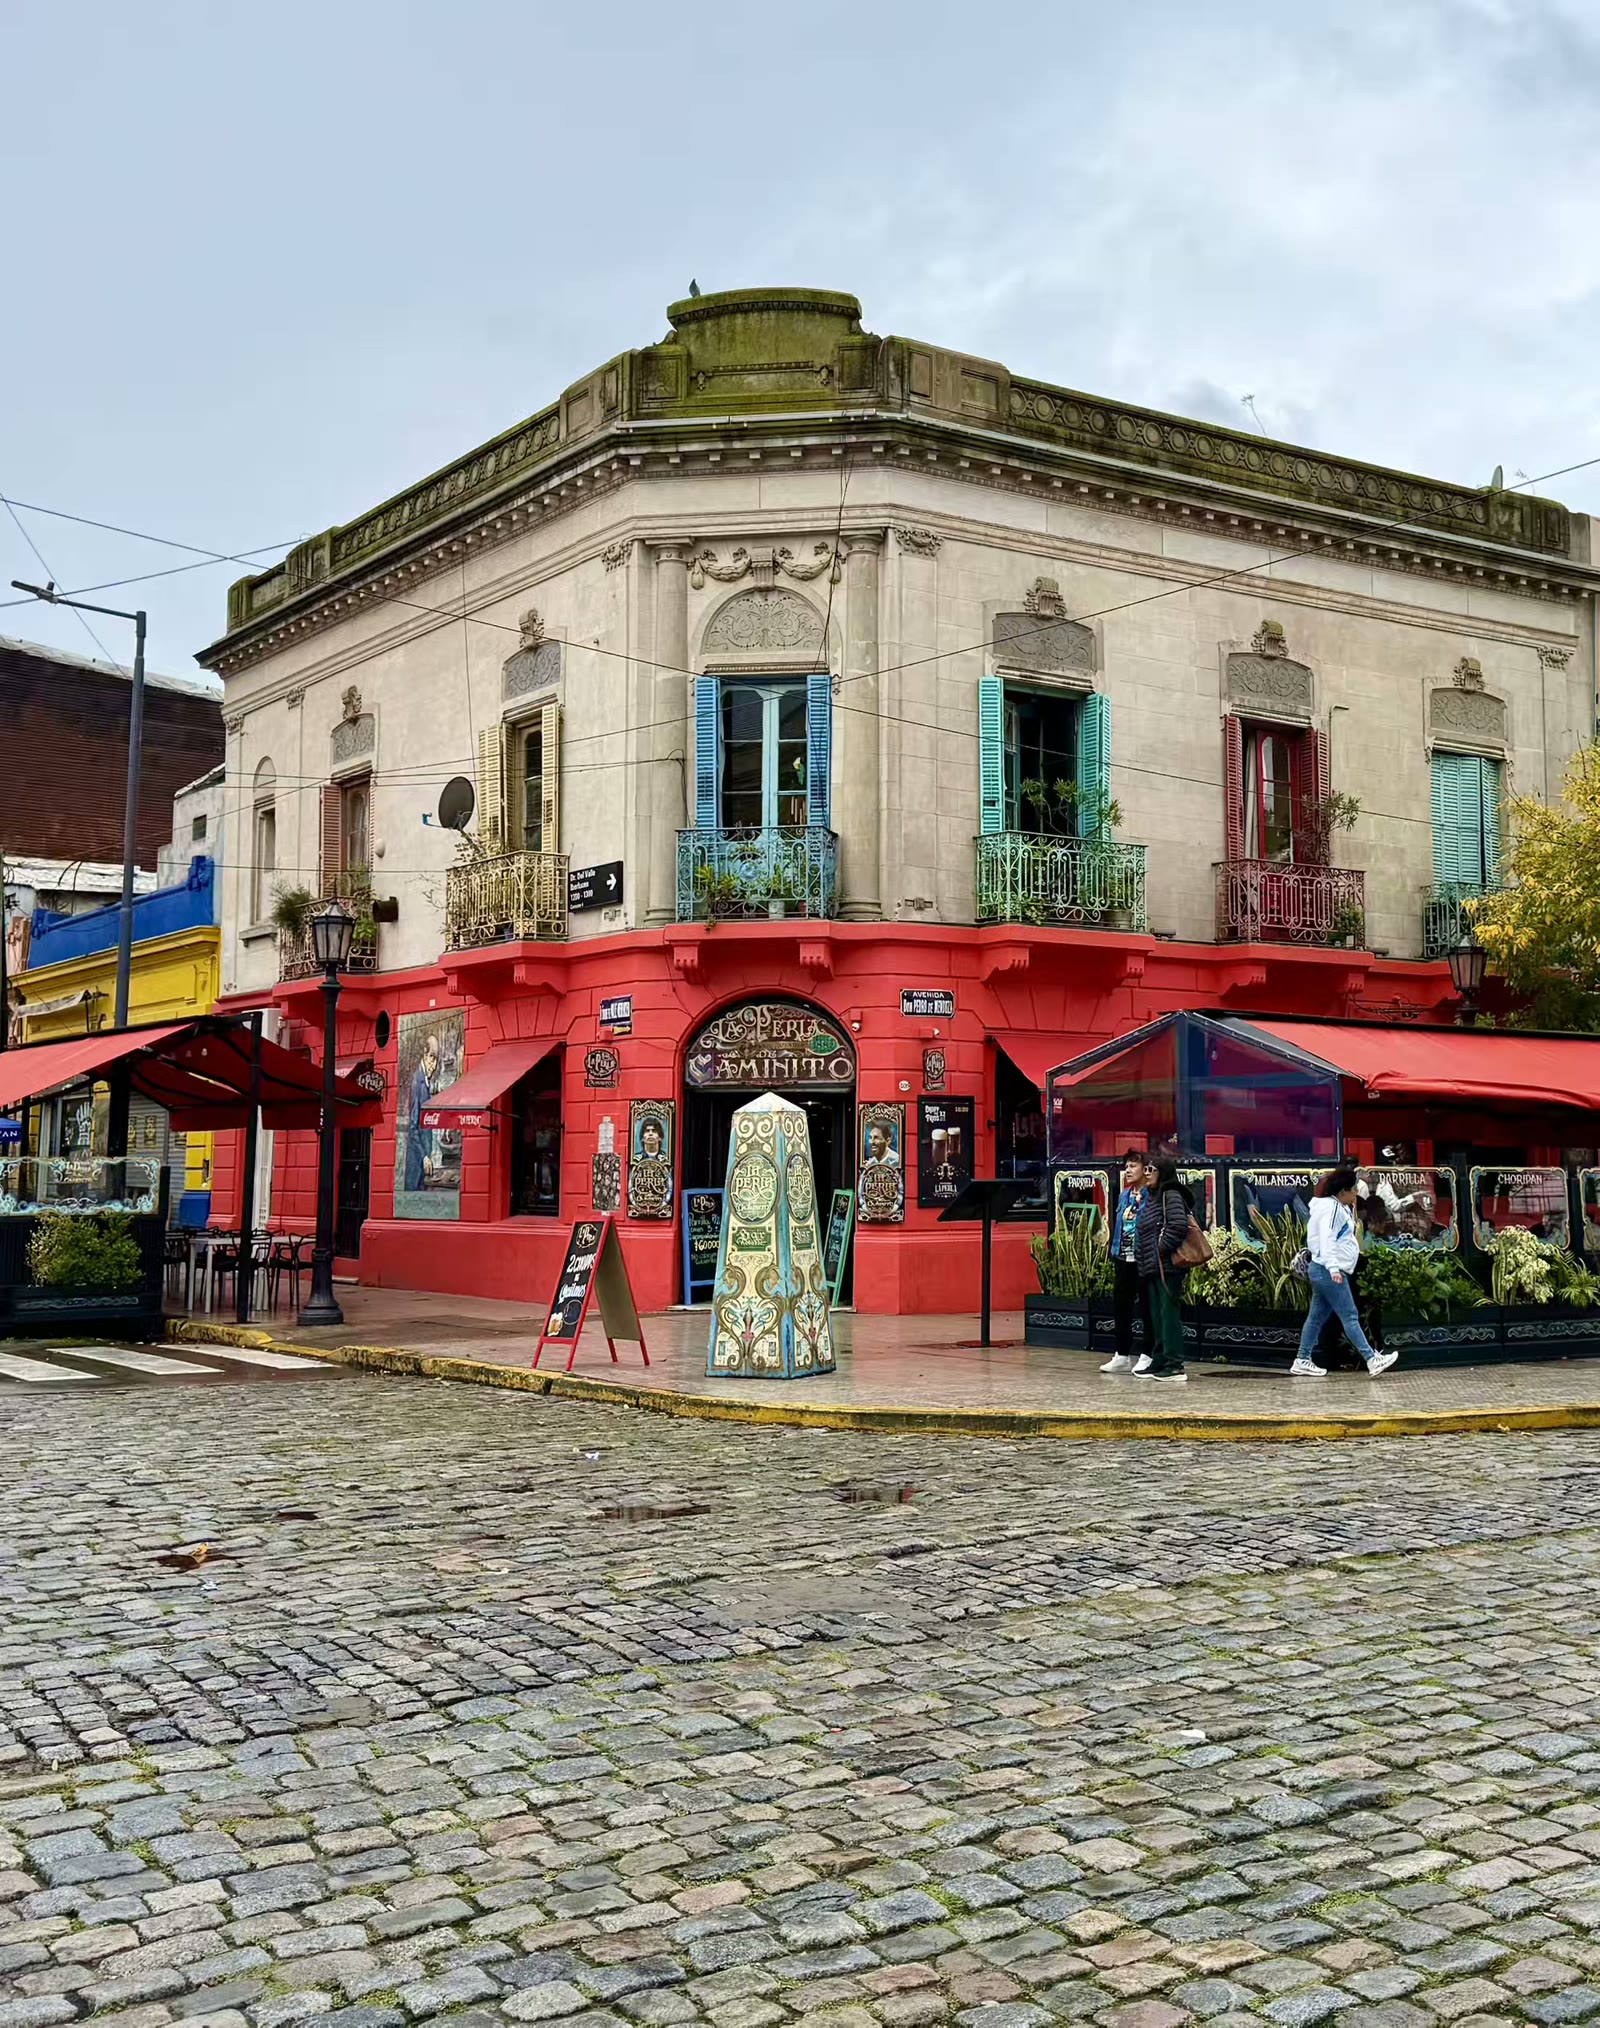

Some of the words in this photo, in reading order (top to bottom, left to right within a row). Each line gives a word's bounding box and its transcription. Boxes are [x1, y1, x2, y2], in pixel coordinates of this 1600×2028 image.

[570, 892, 580, 901] 1200
[583, 890, 594, 898] 1300
[738, 1004, 827, 1043] PERLA
[689, 1053, 853, 1081] CAMINITO
[0, 1130, 18, 1138] AN
[1253, 1174, 1309, 1187] MILANESAS
[1379, 1172, 1426, 1186] PARRILLA
[1498, 1174, 1543, 1185] CHORIPAN
[735, 1177, 774, 1195] PERLA
